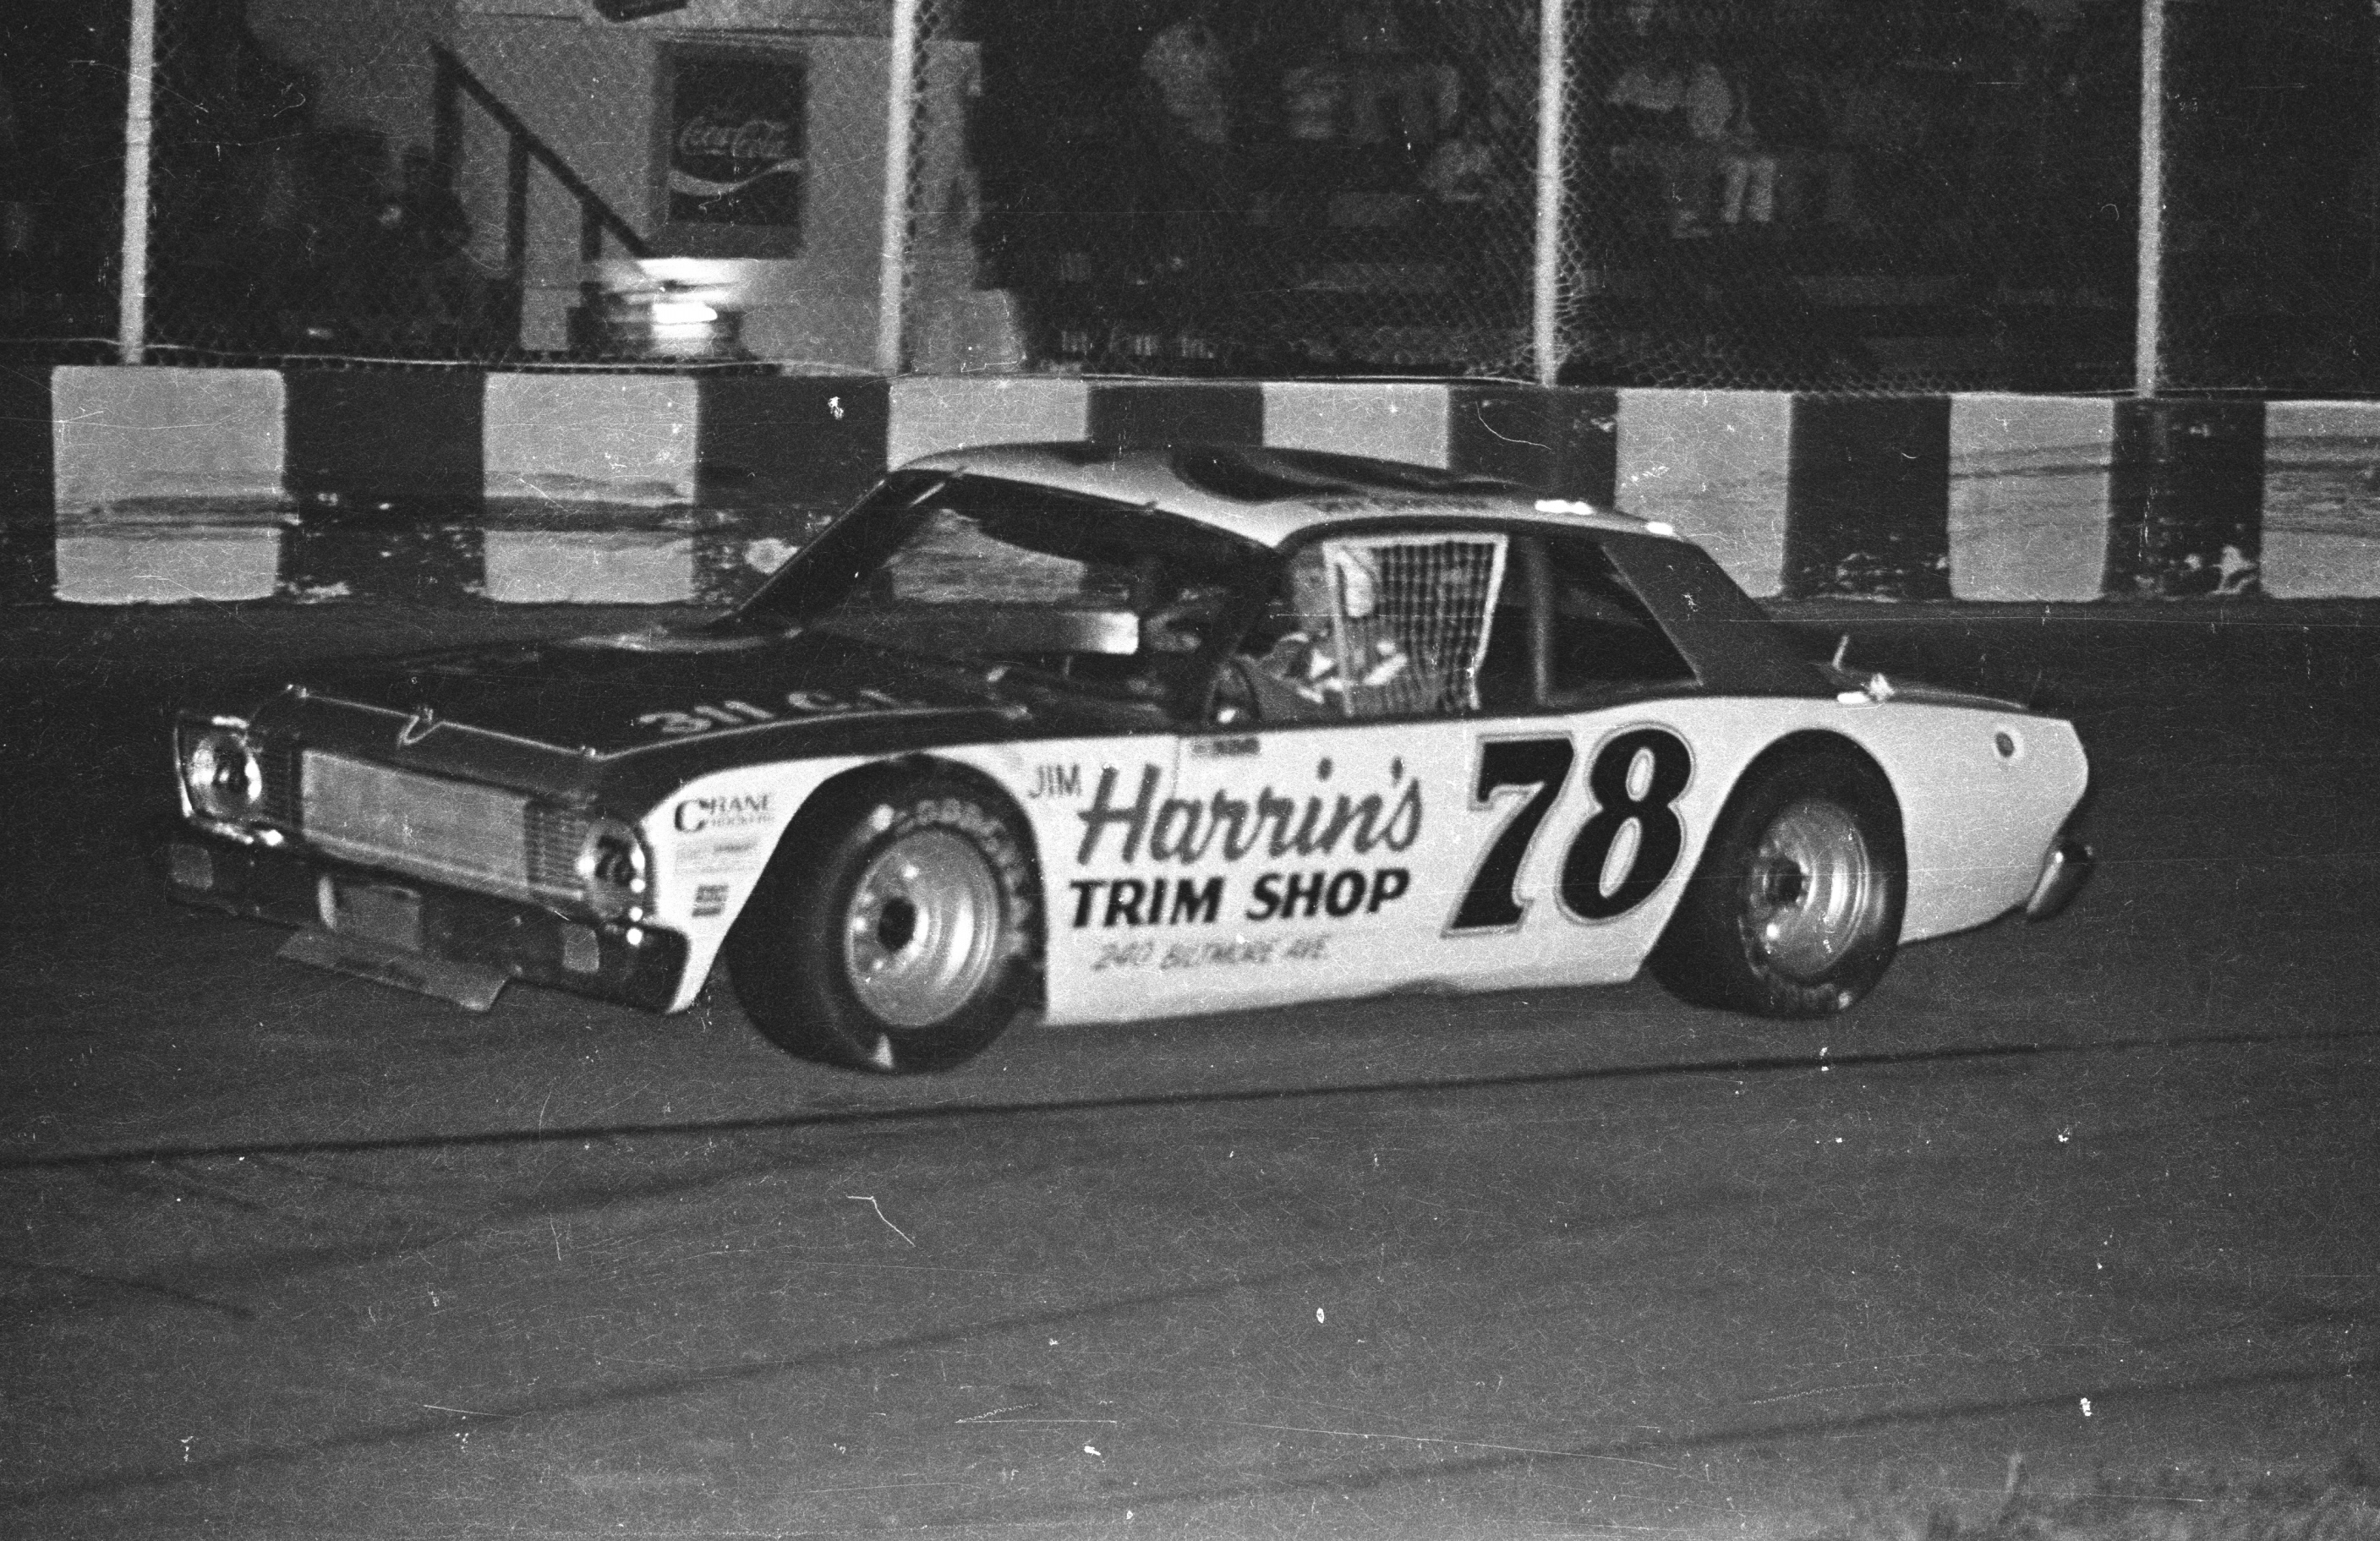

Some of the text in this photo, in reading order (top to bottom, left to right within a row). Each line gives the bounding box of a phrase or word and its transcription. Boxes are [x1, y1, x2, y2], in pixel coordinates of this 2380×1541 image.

[1027, 764, 1081, 799] JIM
[1077, 757, 1423, 865] Harrin's
[1440, 720, 1696, 939] 78
[1070, 867, 1410, 928] TRIM SHOP
